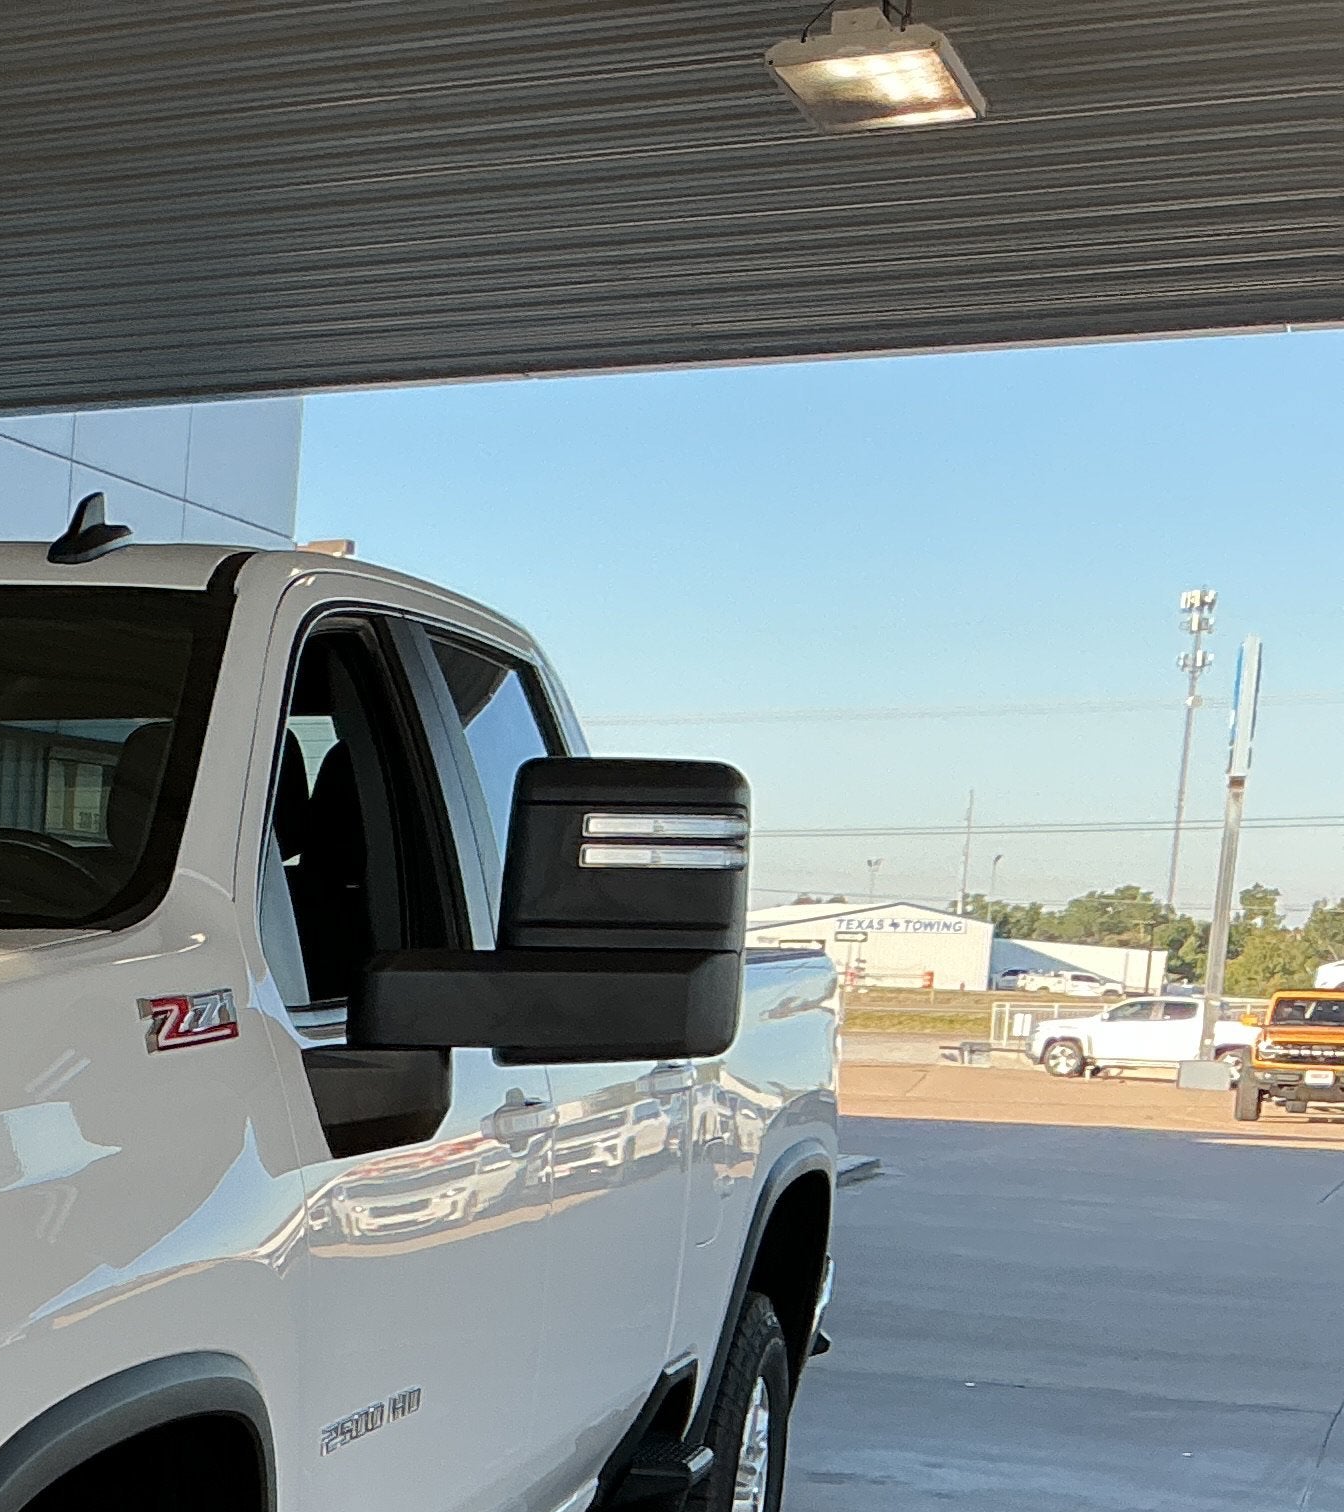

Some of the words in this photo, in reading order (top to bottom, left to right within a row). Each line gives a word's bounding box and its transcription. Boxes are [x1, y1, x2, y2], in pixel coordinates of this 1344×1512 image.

[836, 918, 884, 930] TEXAS
[904, 919, 962, 932] TOWING
[319, 1401, 384, 1456] 2500
[387, 1384, 422, 1423] HD
